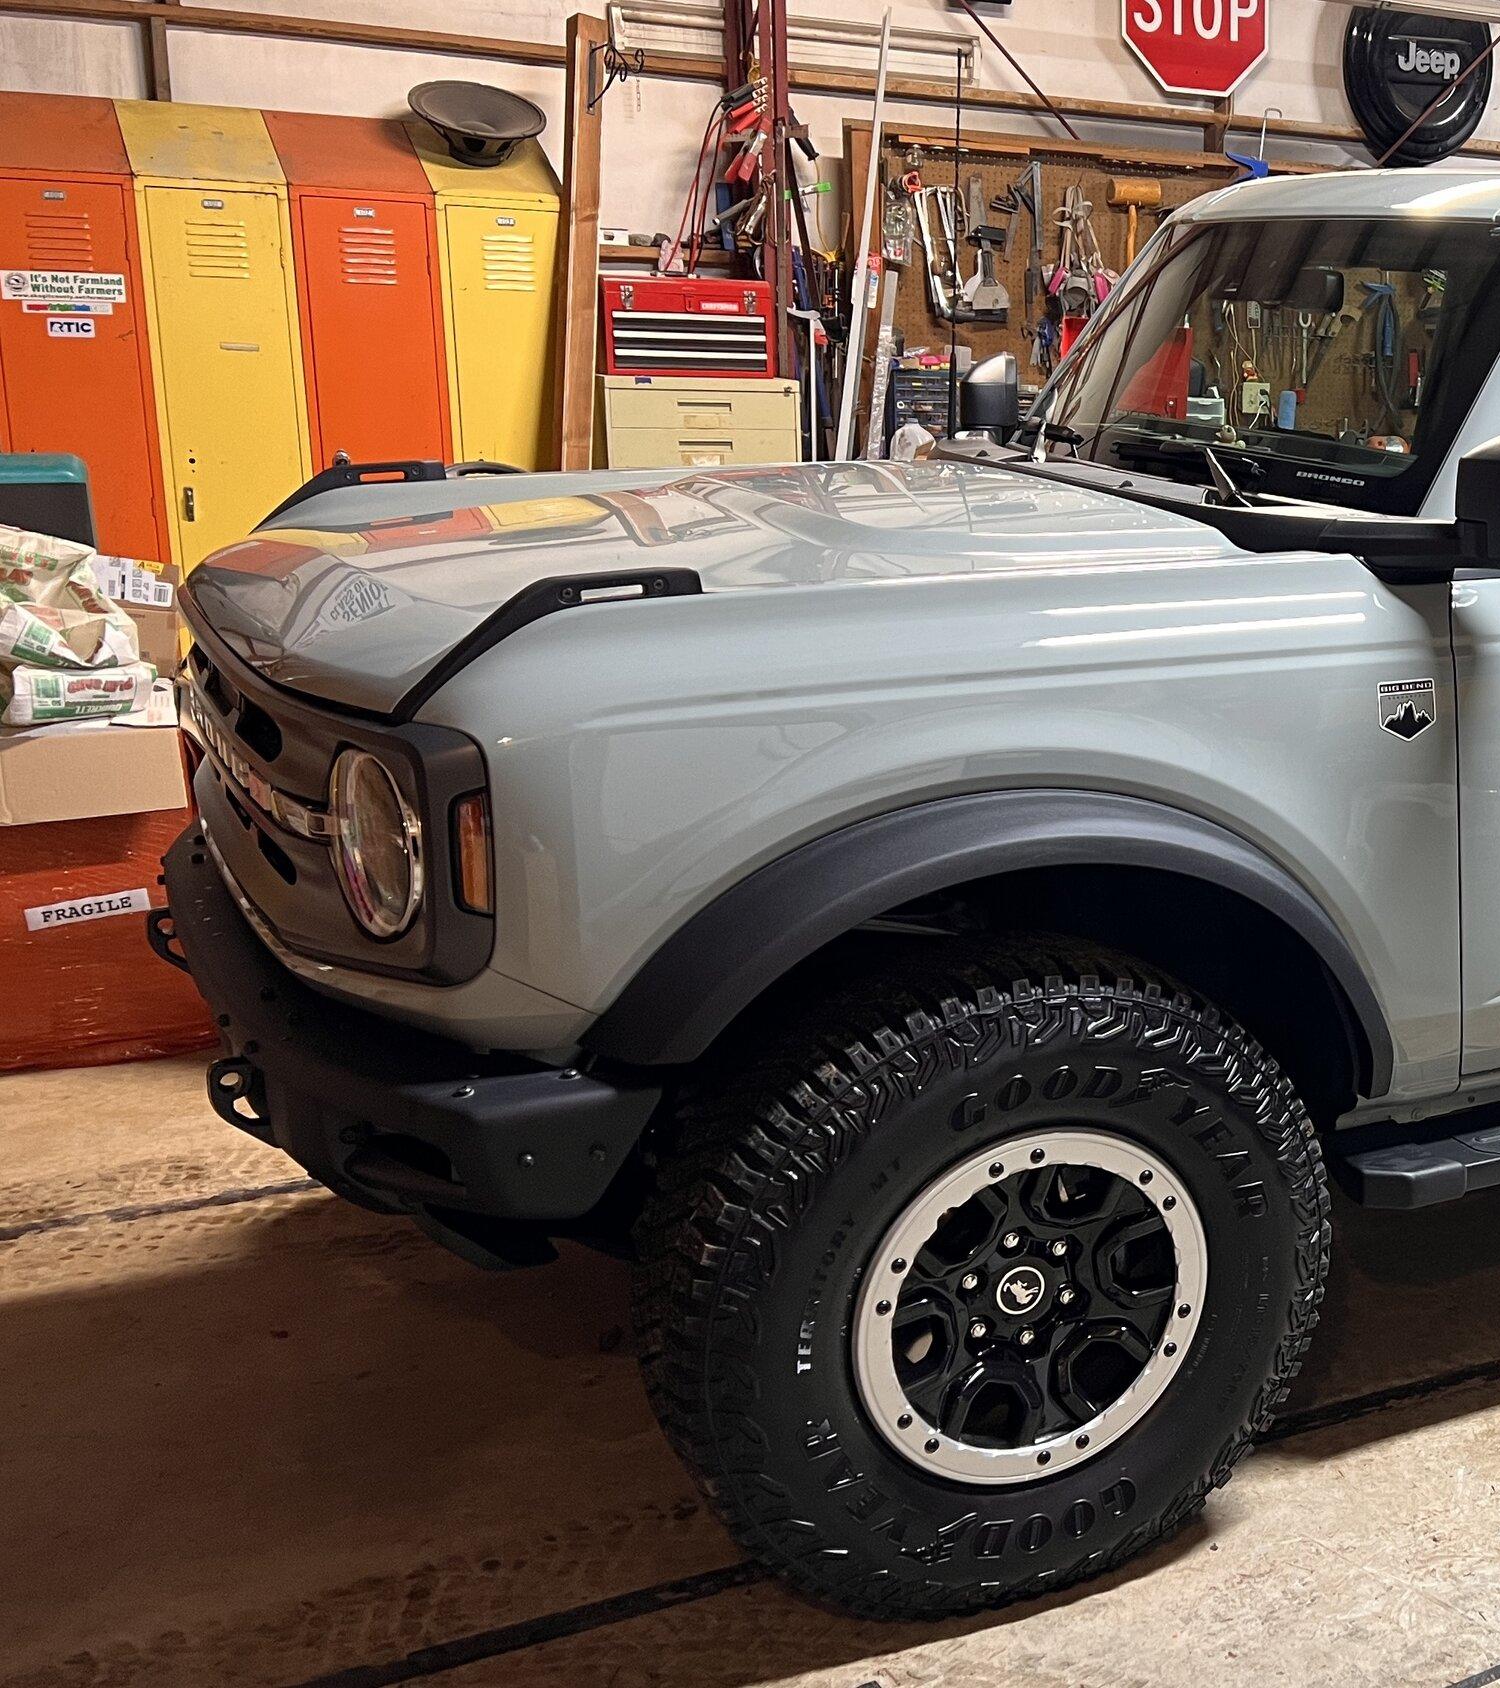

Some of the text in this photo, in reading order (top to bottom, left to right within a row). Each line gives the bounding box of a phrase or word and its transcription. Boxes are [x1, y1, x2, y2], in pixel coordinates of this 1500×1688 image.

[1133, 0, 1258, 41] STOP
[1398, 38, 1460, 80] Jeep
[30, 273, 48, 283] It's
[51, 275, 71, 284] Not
[73, 275, 123, 286] Farmland
[31, 284, 123, 296] Without Farmers
[49, 321, 92, 333] RTIC
[1296, 471, 1365, 487] BRONCO
[1401, 682, 1432, 691] BEND
[41, 896, 132, 923] FRAGILE
